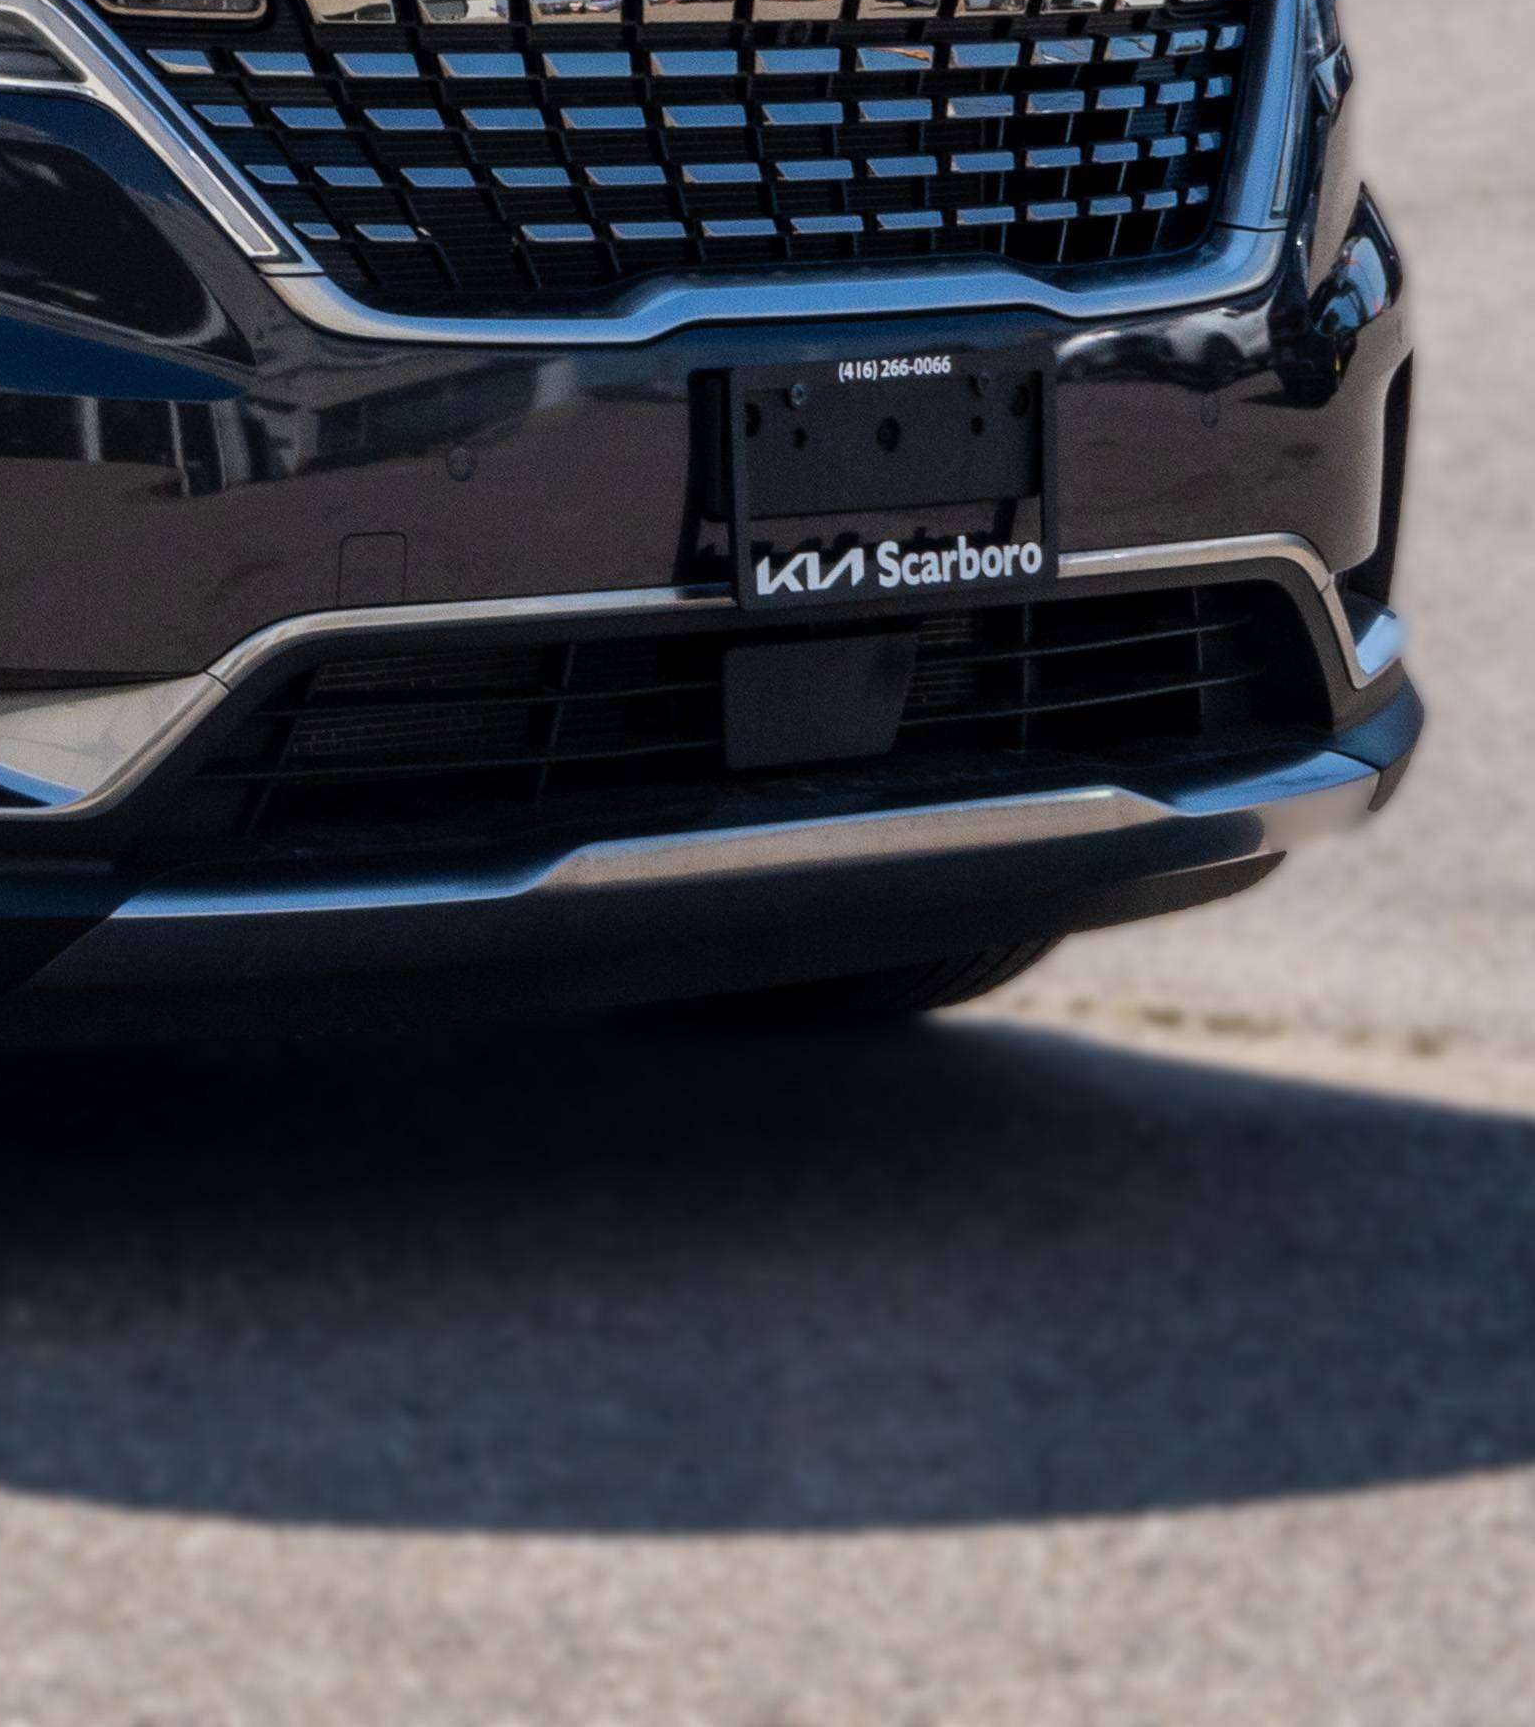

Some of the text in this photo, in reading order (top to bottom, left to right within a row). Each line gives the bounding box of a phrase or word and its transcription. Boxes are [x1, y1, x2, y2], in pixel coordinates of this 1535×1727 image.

[838, 355, 951, 383] (416) 266-0066
[756, 535, 1043, 596] KIA Scarboro
